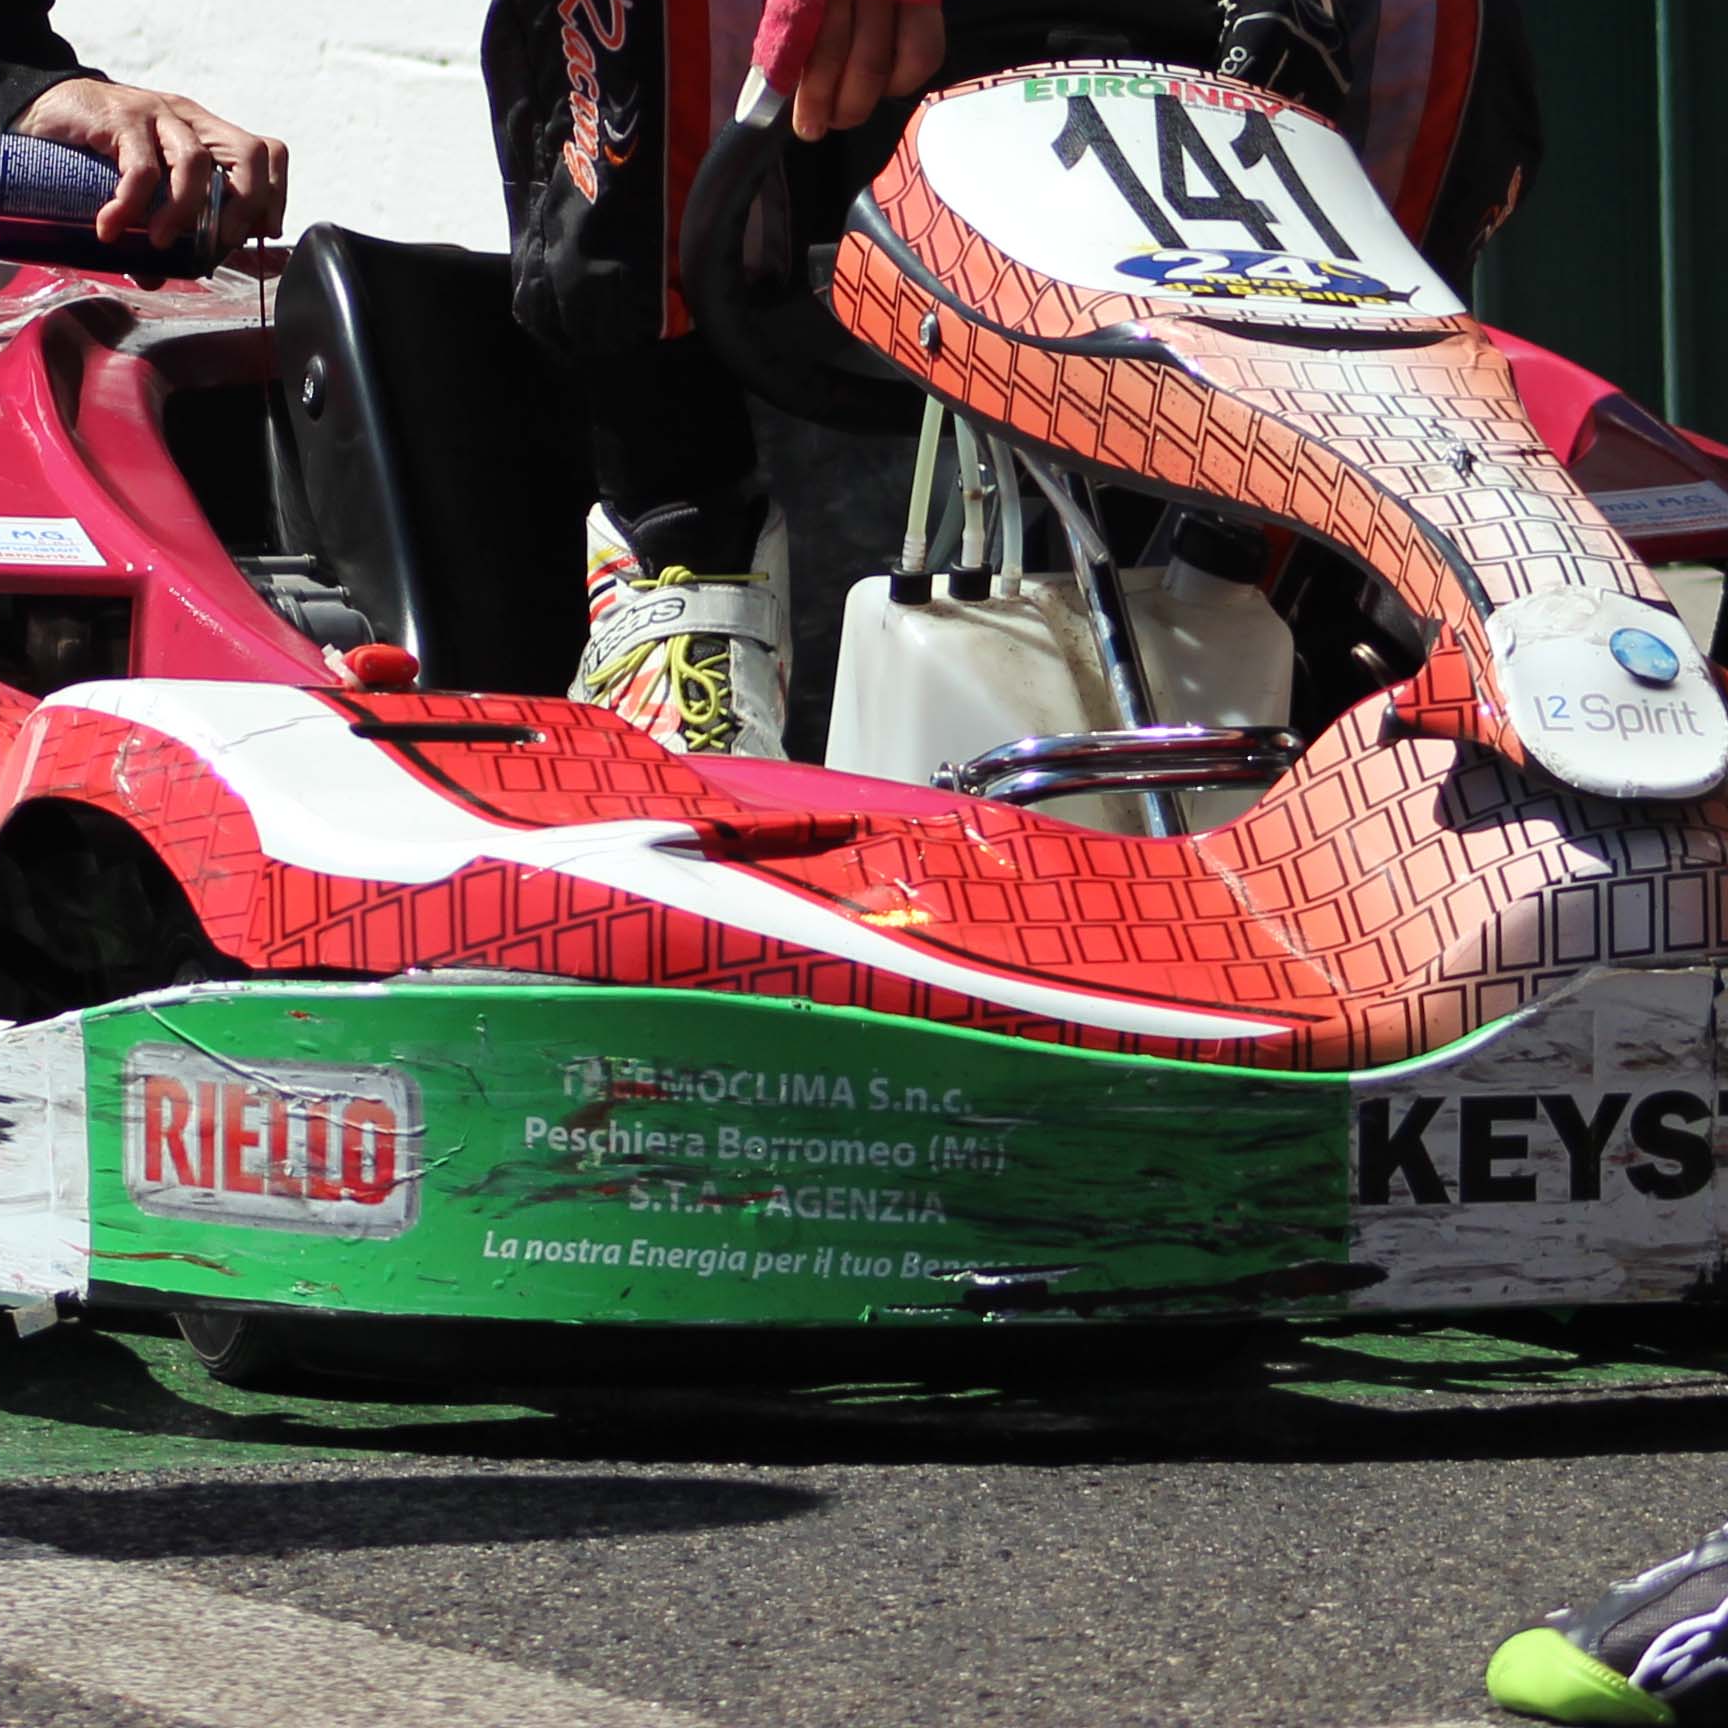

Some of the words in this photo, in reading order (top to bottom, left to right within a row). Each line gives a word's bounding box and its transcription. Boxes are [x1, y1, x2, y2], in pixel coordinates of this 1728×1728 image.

[1023, 76, 1285, 120] EUROINDY
[1051, 94, 1361, 262] 141
[1151, 249, 1330, 287] 24
[1579, 692, 1706, 741] Spirit
[142, 1075, 397, 1207] RIELLO
[523, 1116, 706, 1160] Peschiera
[717, 1126, 917, 1166] Borromeo
[763, 1186, 948, 1225] AGENZIA
[482, 1229, 517, 1260] La
[524, 1234, 621, 1265] nostra
[628, 1237, 747, 1274] Energia
[754, 1250, 808, 1280] per
[839, 1250, 893, 1279] tuo
